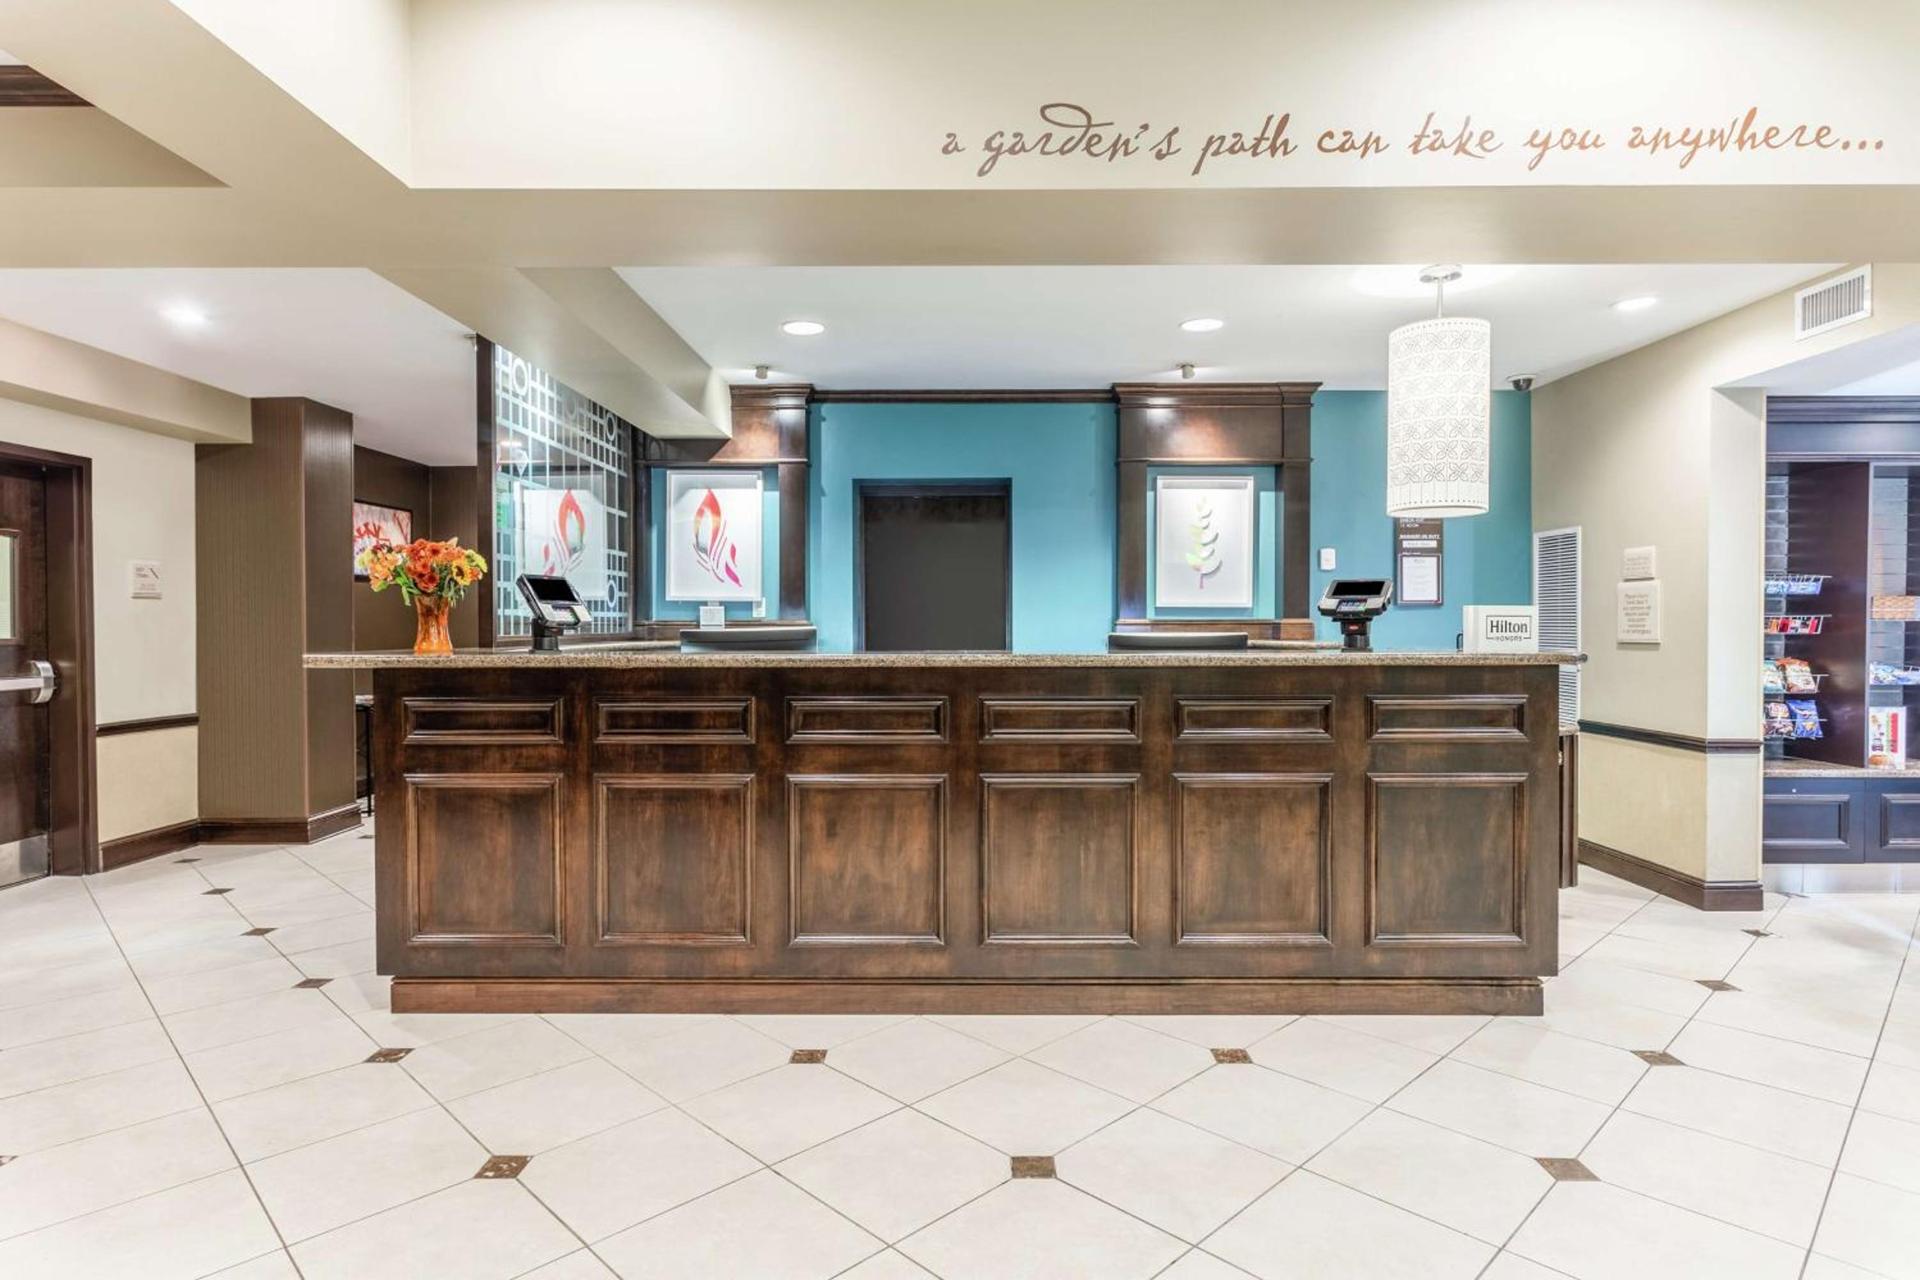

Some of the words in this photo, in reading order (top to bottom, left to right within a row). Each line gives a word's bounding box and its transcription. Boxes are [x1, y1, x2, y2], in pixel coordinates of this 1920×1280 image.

[941, 132, 967, 156] a
[976, 102, 1182, 178] garden's
[1190, 112, 1299, 177] path
[1316, 129, 1391, 160] can
[1407, 111, 1504, 160] take
[1521, 127, 1607, 172] you
[1490, 620, 1528, 633] Hilton
